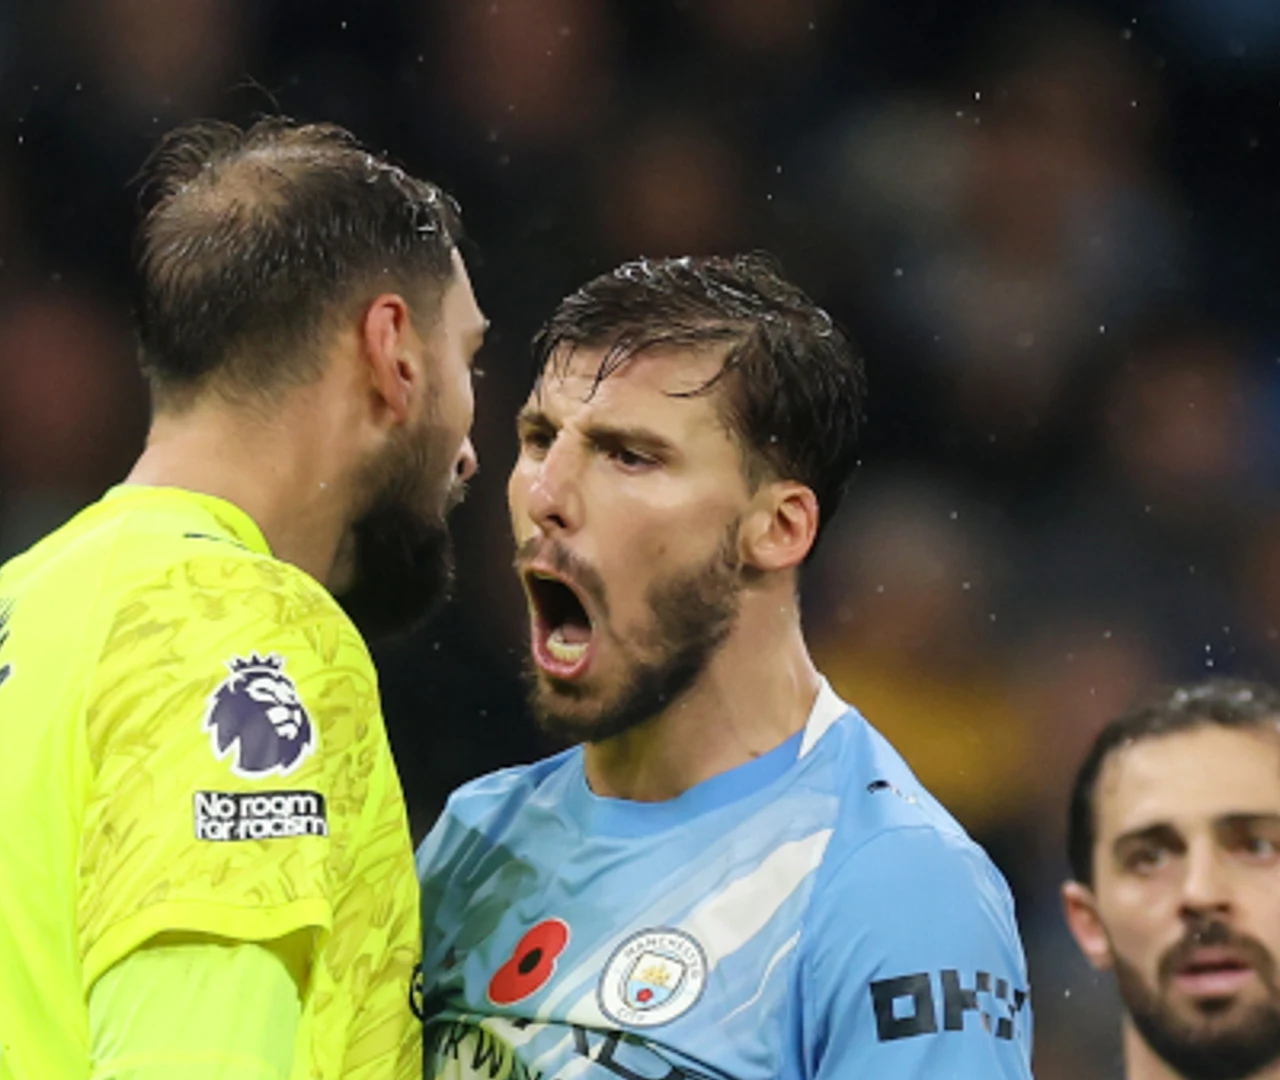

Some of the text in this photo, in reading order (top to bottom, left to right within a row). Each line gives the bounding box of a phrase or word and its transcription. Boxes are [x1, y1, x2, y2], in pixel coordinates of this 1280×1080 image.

[194, 792, 318, 819] No room
[195, 815, 328, 840] for racism
